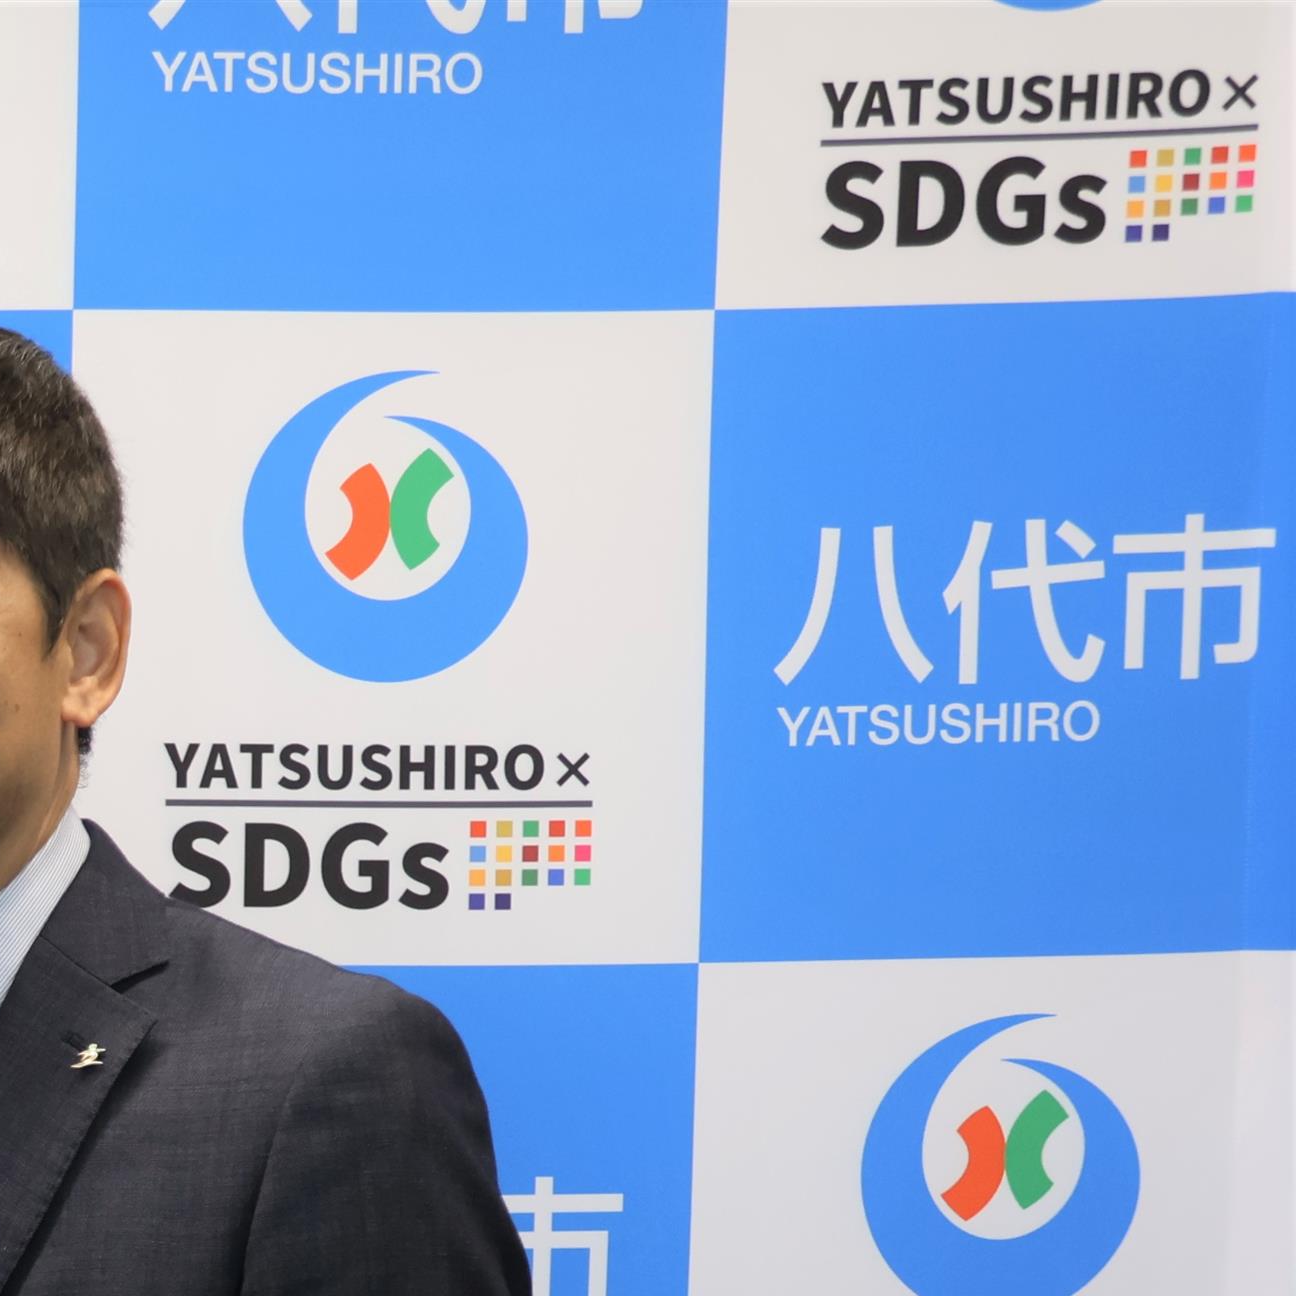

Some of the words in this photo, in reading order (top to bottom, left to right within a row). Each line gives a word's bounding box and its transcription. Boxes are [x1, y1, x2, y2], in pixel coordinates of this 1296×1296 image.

[154, 53, 483, 95] YATSUSHIRO
[823, 157, 1107, 250] SDGs
[775, 515, 1277, 685] 八代市
[779, 701, 1100, 747] YATSUSHIRO
[168, 820, 450, 910] SDGs
